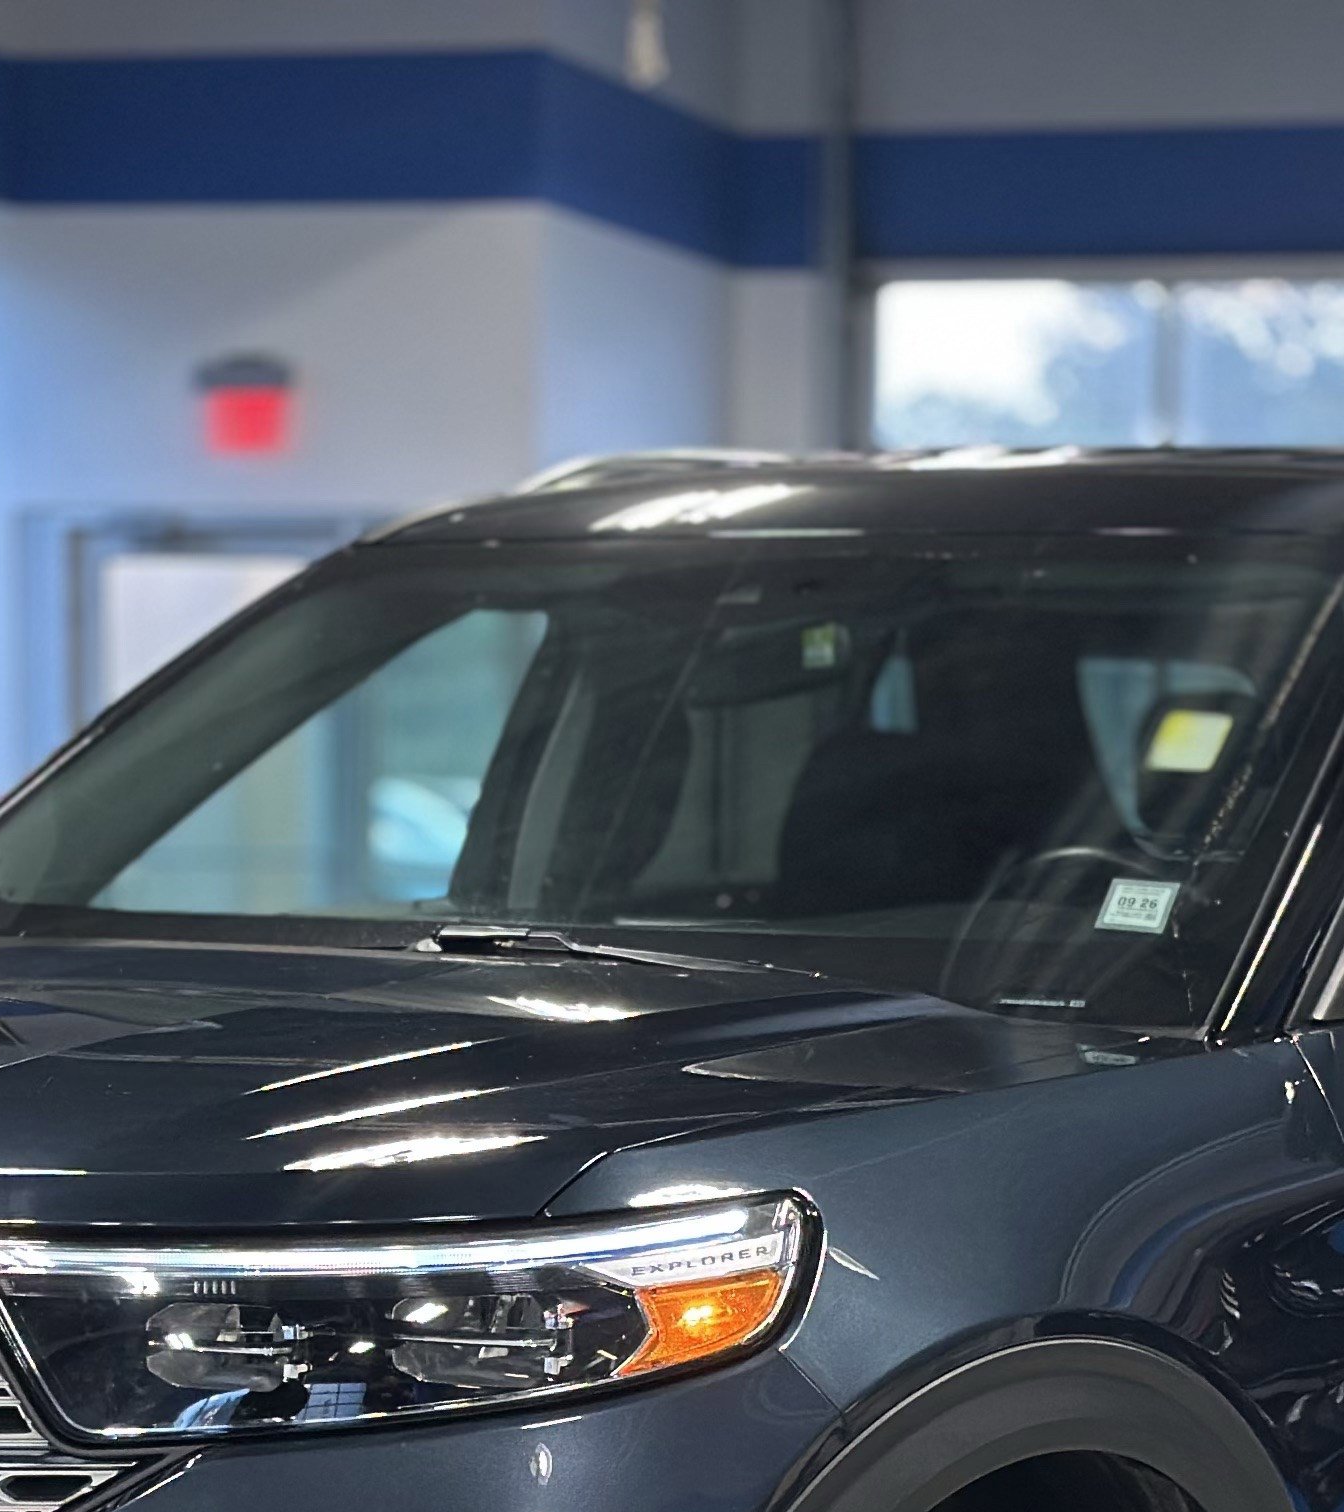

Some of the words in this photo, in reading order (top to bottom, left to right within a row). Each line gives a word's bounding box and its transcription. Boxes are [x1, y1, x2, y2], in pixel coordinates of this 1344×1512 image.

[1117, 896, 1136, 907] 09
[1140, 898, 1159, 909] 26
[630, 1245, 771, 1277] EXPLORER
